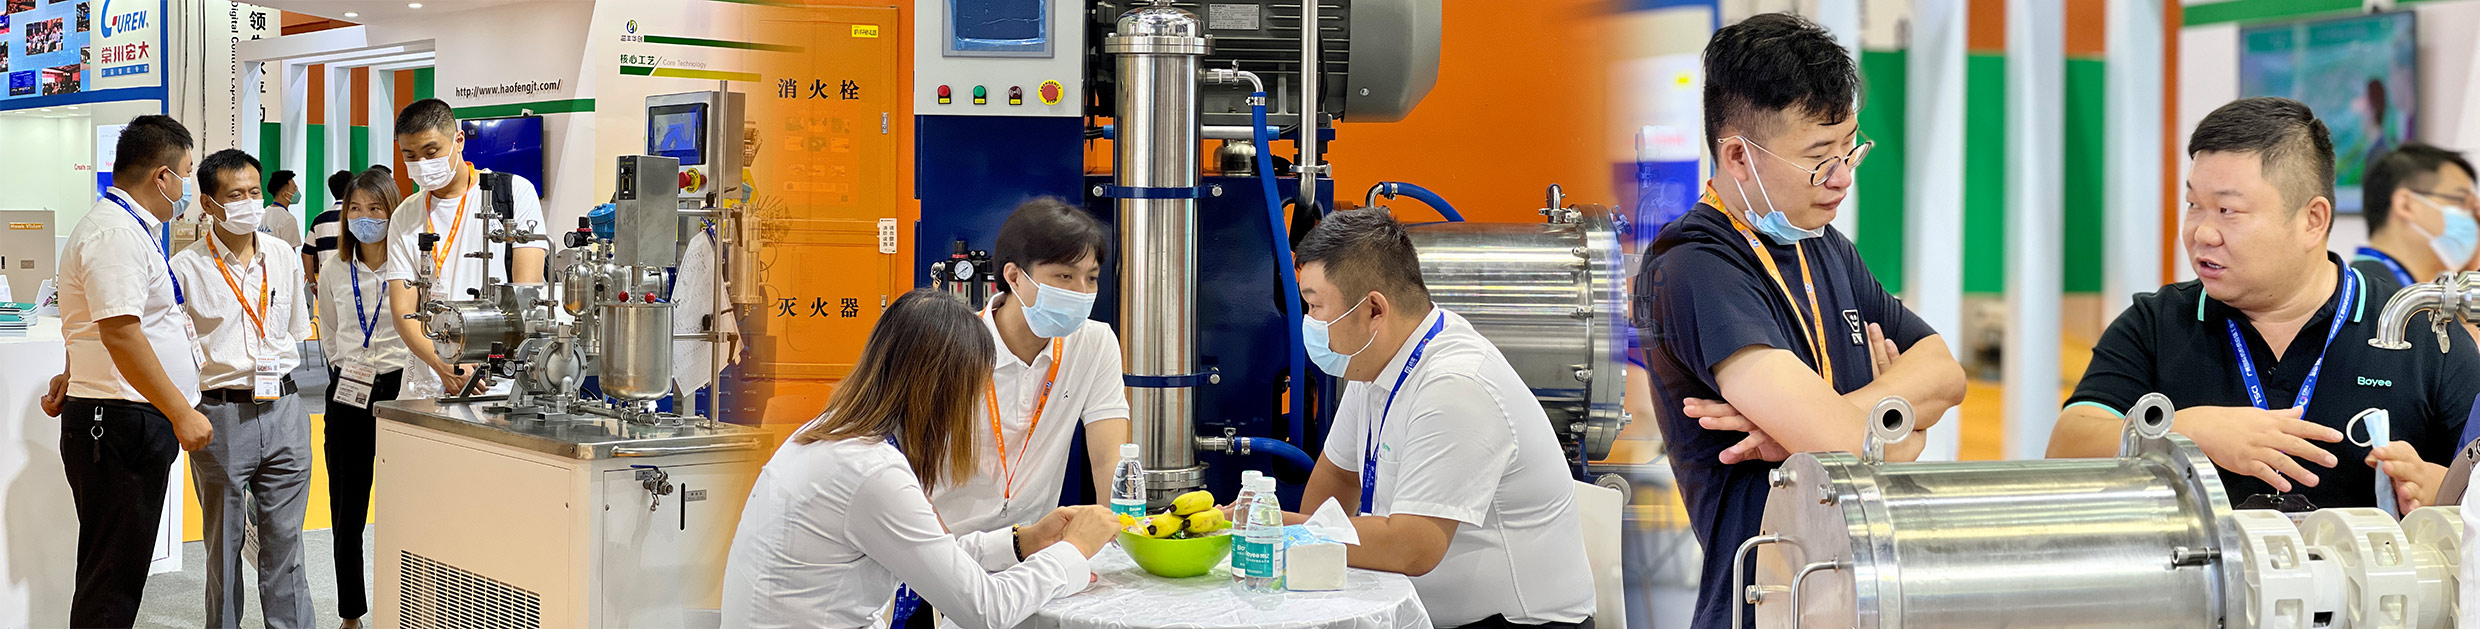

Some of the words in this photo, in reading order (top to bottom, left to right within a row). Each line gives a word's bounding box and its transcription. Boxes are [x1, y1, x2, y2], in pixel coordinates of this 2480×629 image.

[229, 1, 239, 33] Digital
[620, 54, 655, 65] 核心工艺
[678, 60, 706, 68] Technology
[456, 79, 561, 98] http://www.haofengjt.com/
[778, 78, 860, 100] 消火栓
[777, 297, 860, 318] 灭火器
[2357, 376, 2392, 387] Boyee
